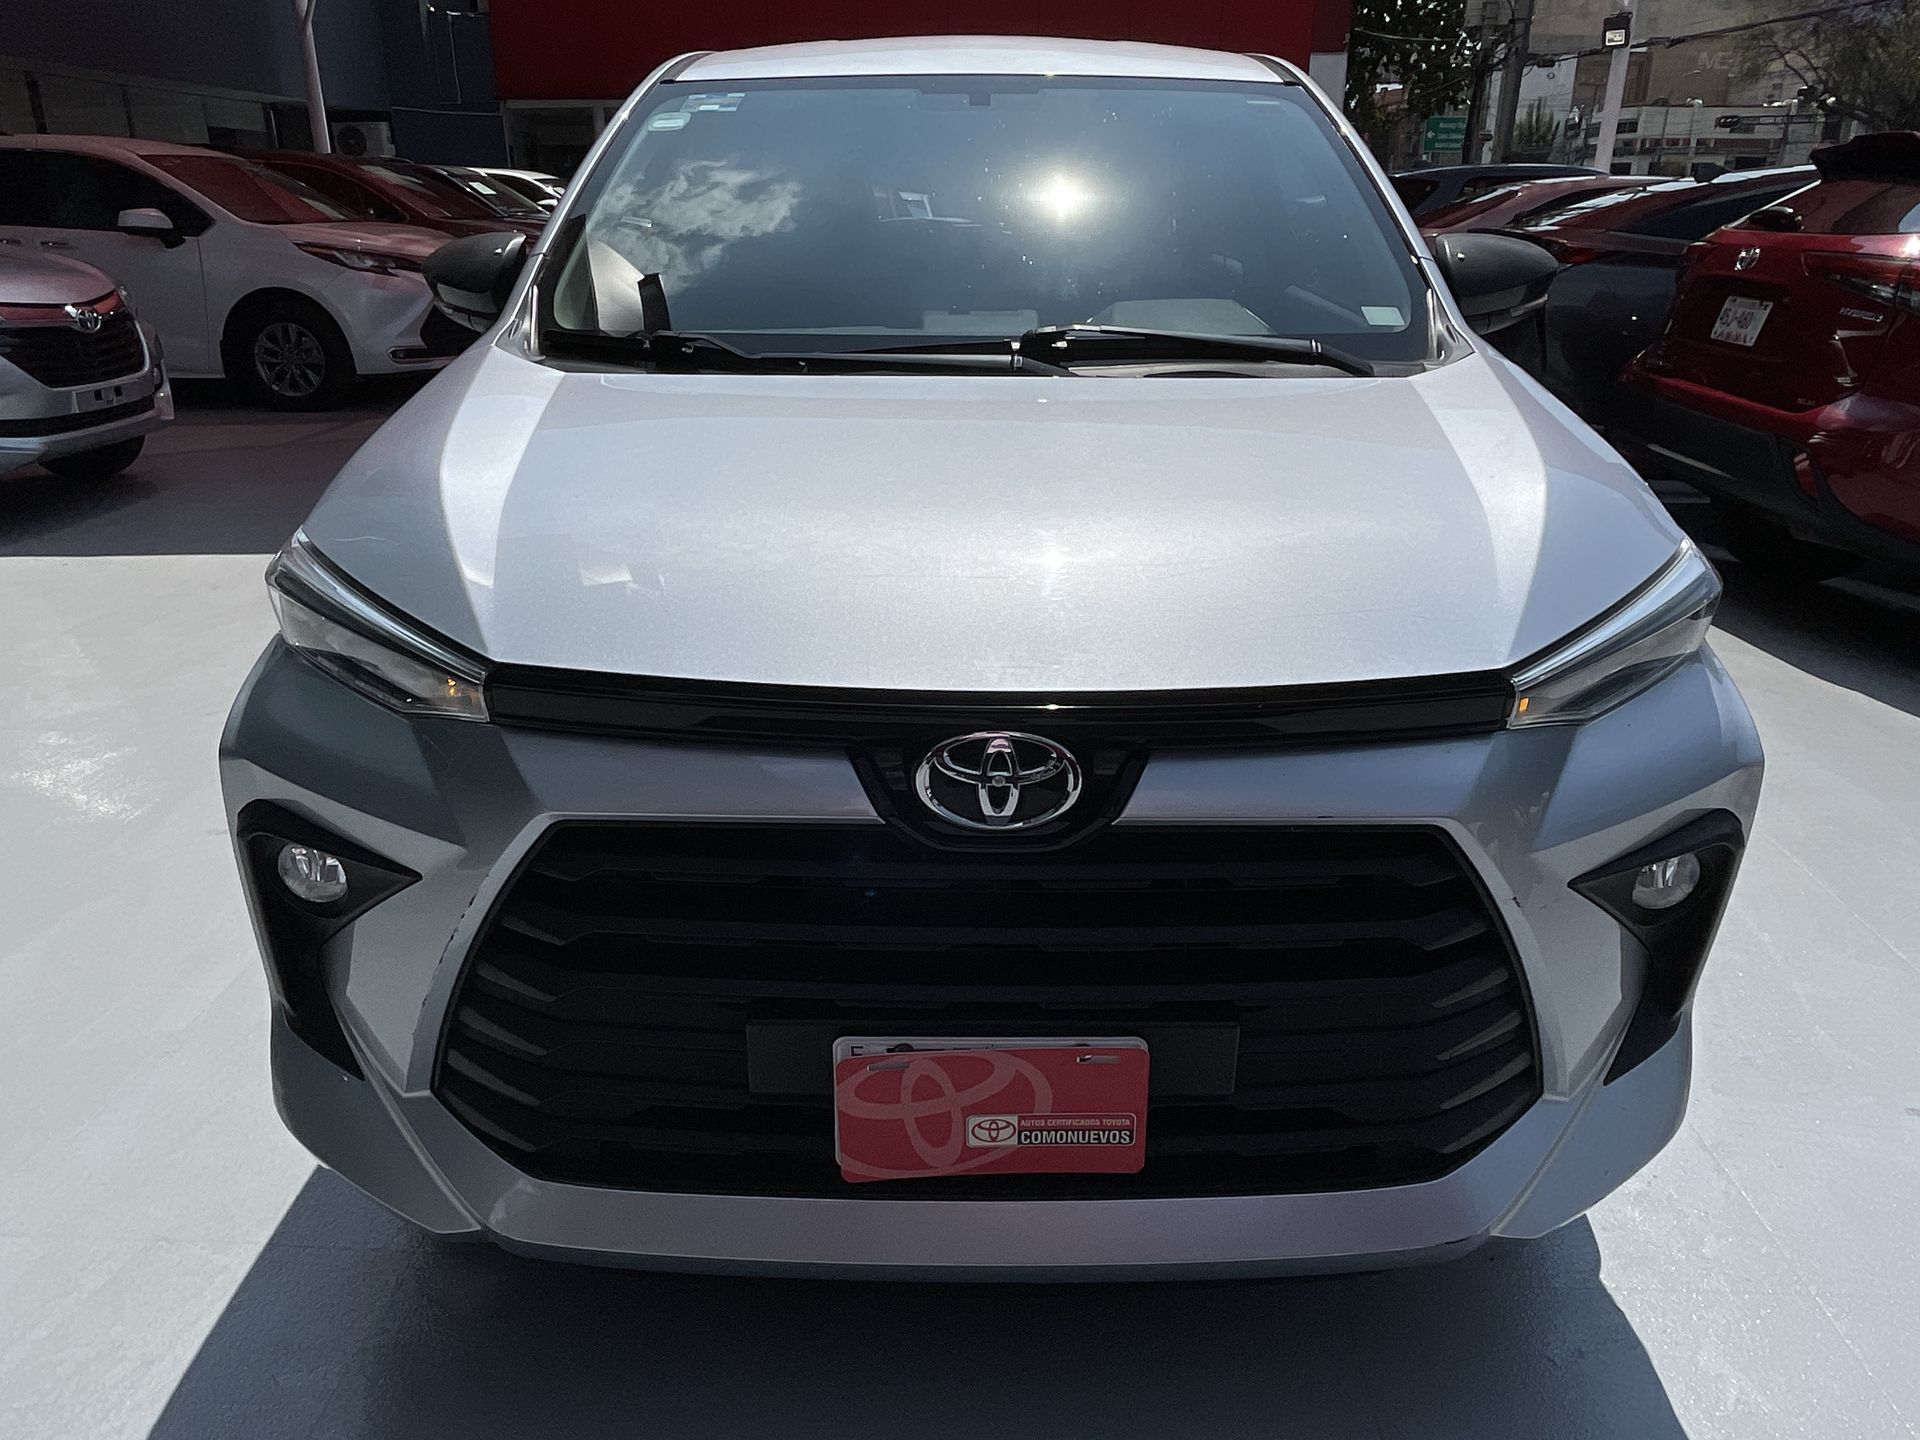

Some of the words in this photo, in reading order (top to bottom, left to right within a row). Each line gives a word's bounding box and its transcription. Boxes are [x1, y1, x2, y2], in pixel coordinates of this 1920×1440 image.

[1020, 1119, 1045, 1127] AUTOS
[1047, 1118, 1100, 1127] CERTIFICADOS
[1102, 1118, 1131, 1126] TOYOTA
[1020, 1130, 1130, 1144] COMONUEVOS
